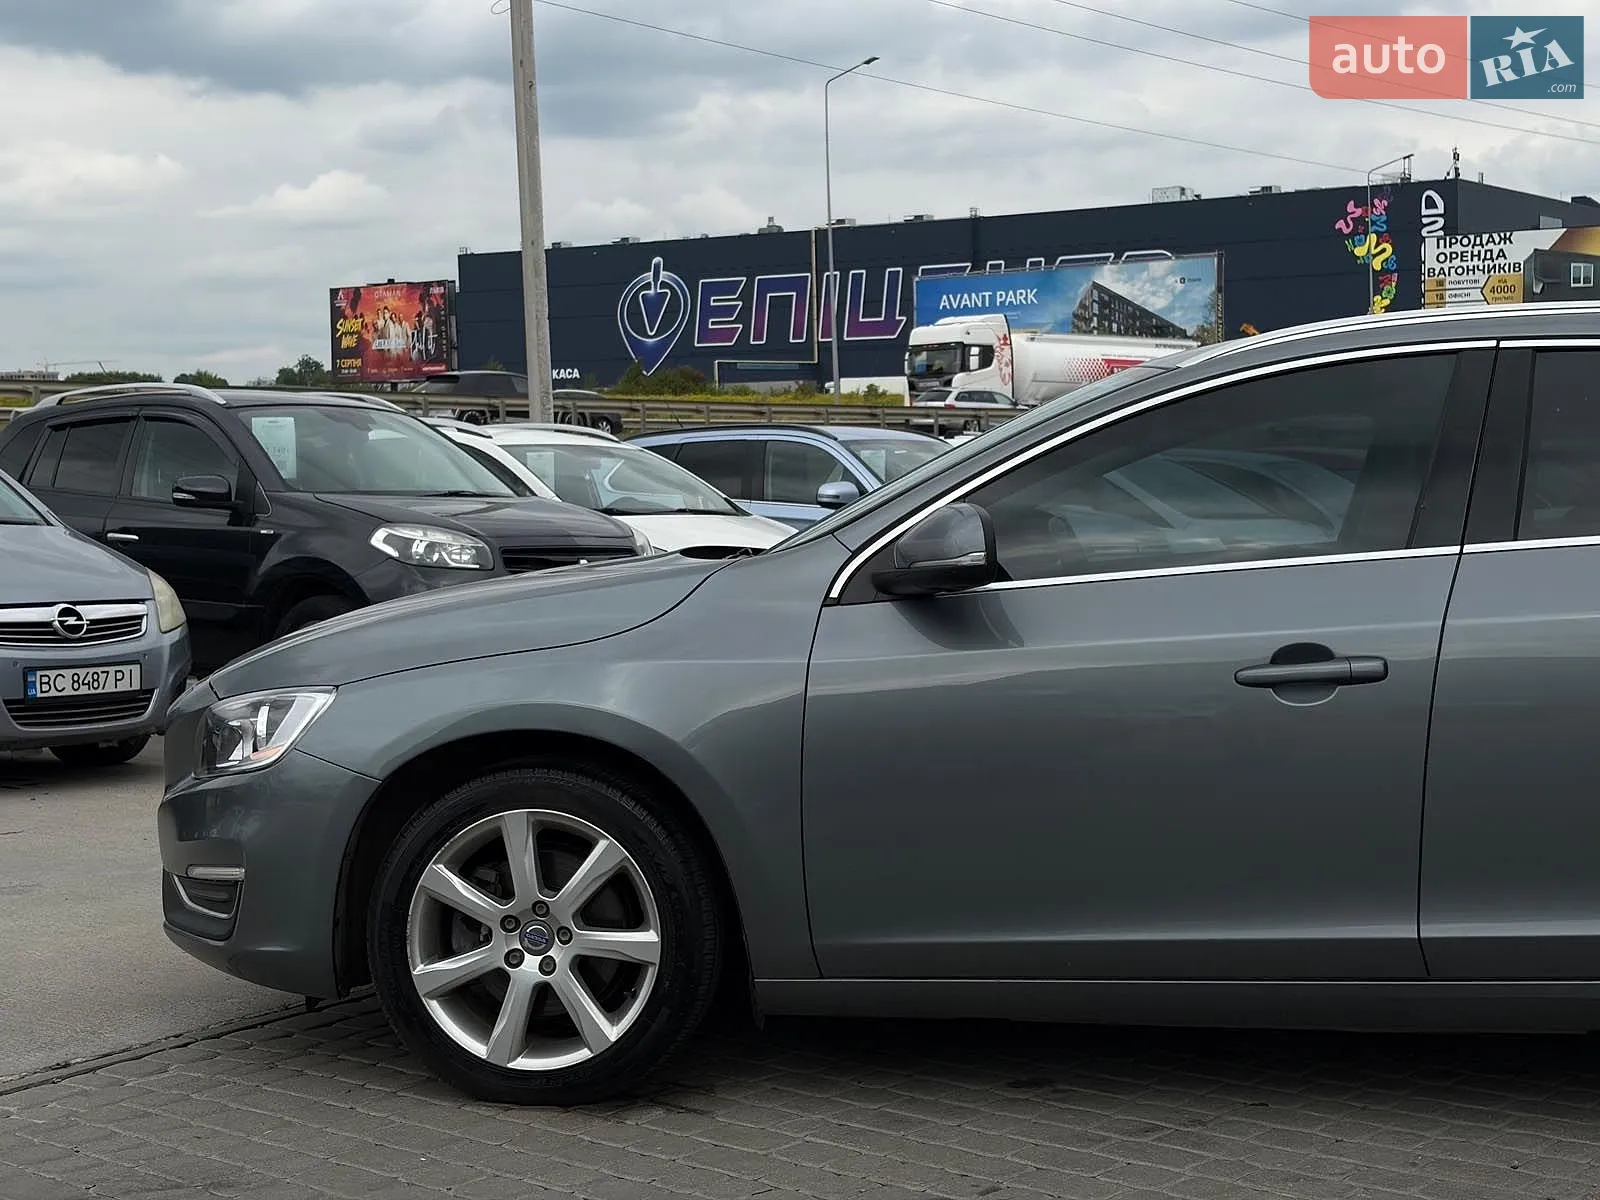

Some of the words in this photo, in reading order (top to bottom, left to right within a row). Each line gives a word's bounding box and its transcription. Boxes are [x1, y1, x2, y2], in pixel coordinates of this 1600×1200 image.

[1436, 233, 1513, 249] ПРОДАЖ
[1436, 248, 1507, 264] ОРЕНДА
[1427, 262, 1522, 278] ВАГОНЧИКІВ
[1489, 284, 1516, 294] 4000
[939, 292, 990, 310] AVANT
[996, 288, 1039, 306] PARK
[552, 368, 580, 380] КАСА
[71, 671, 110, 692] 8487
